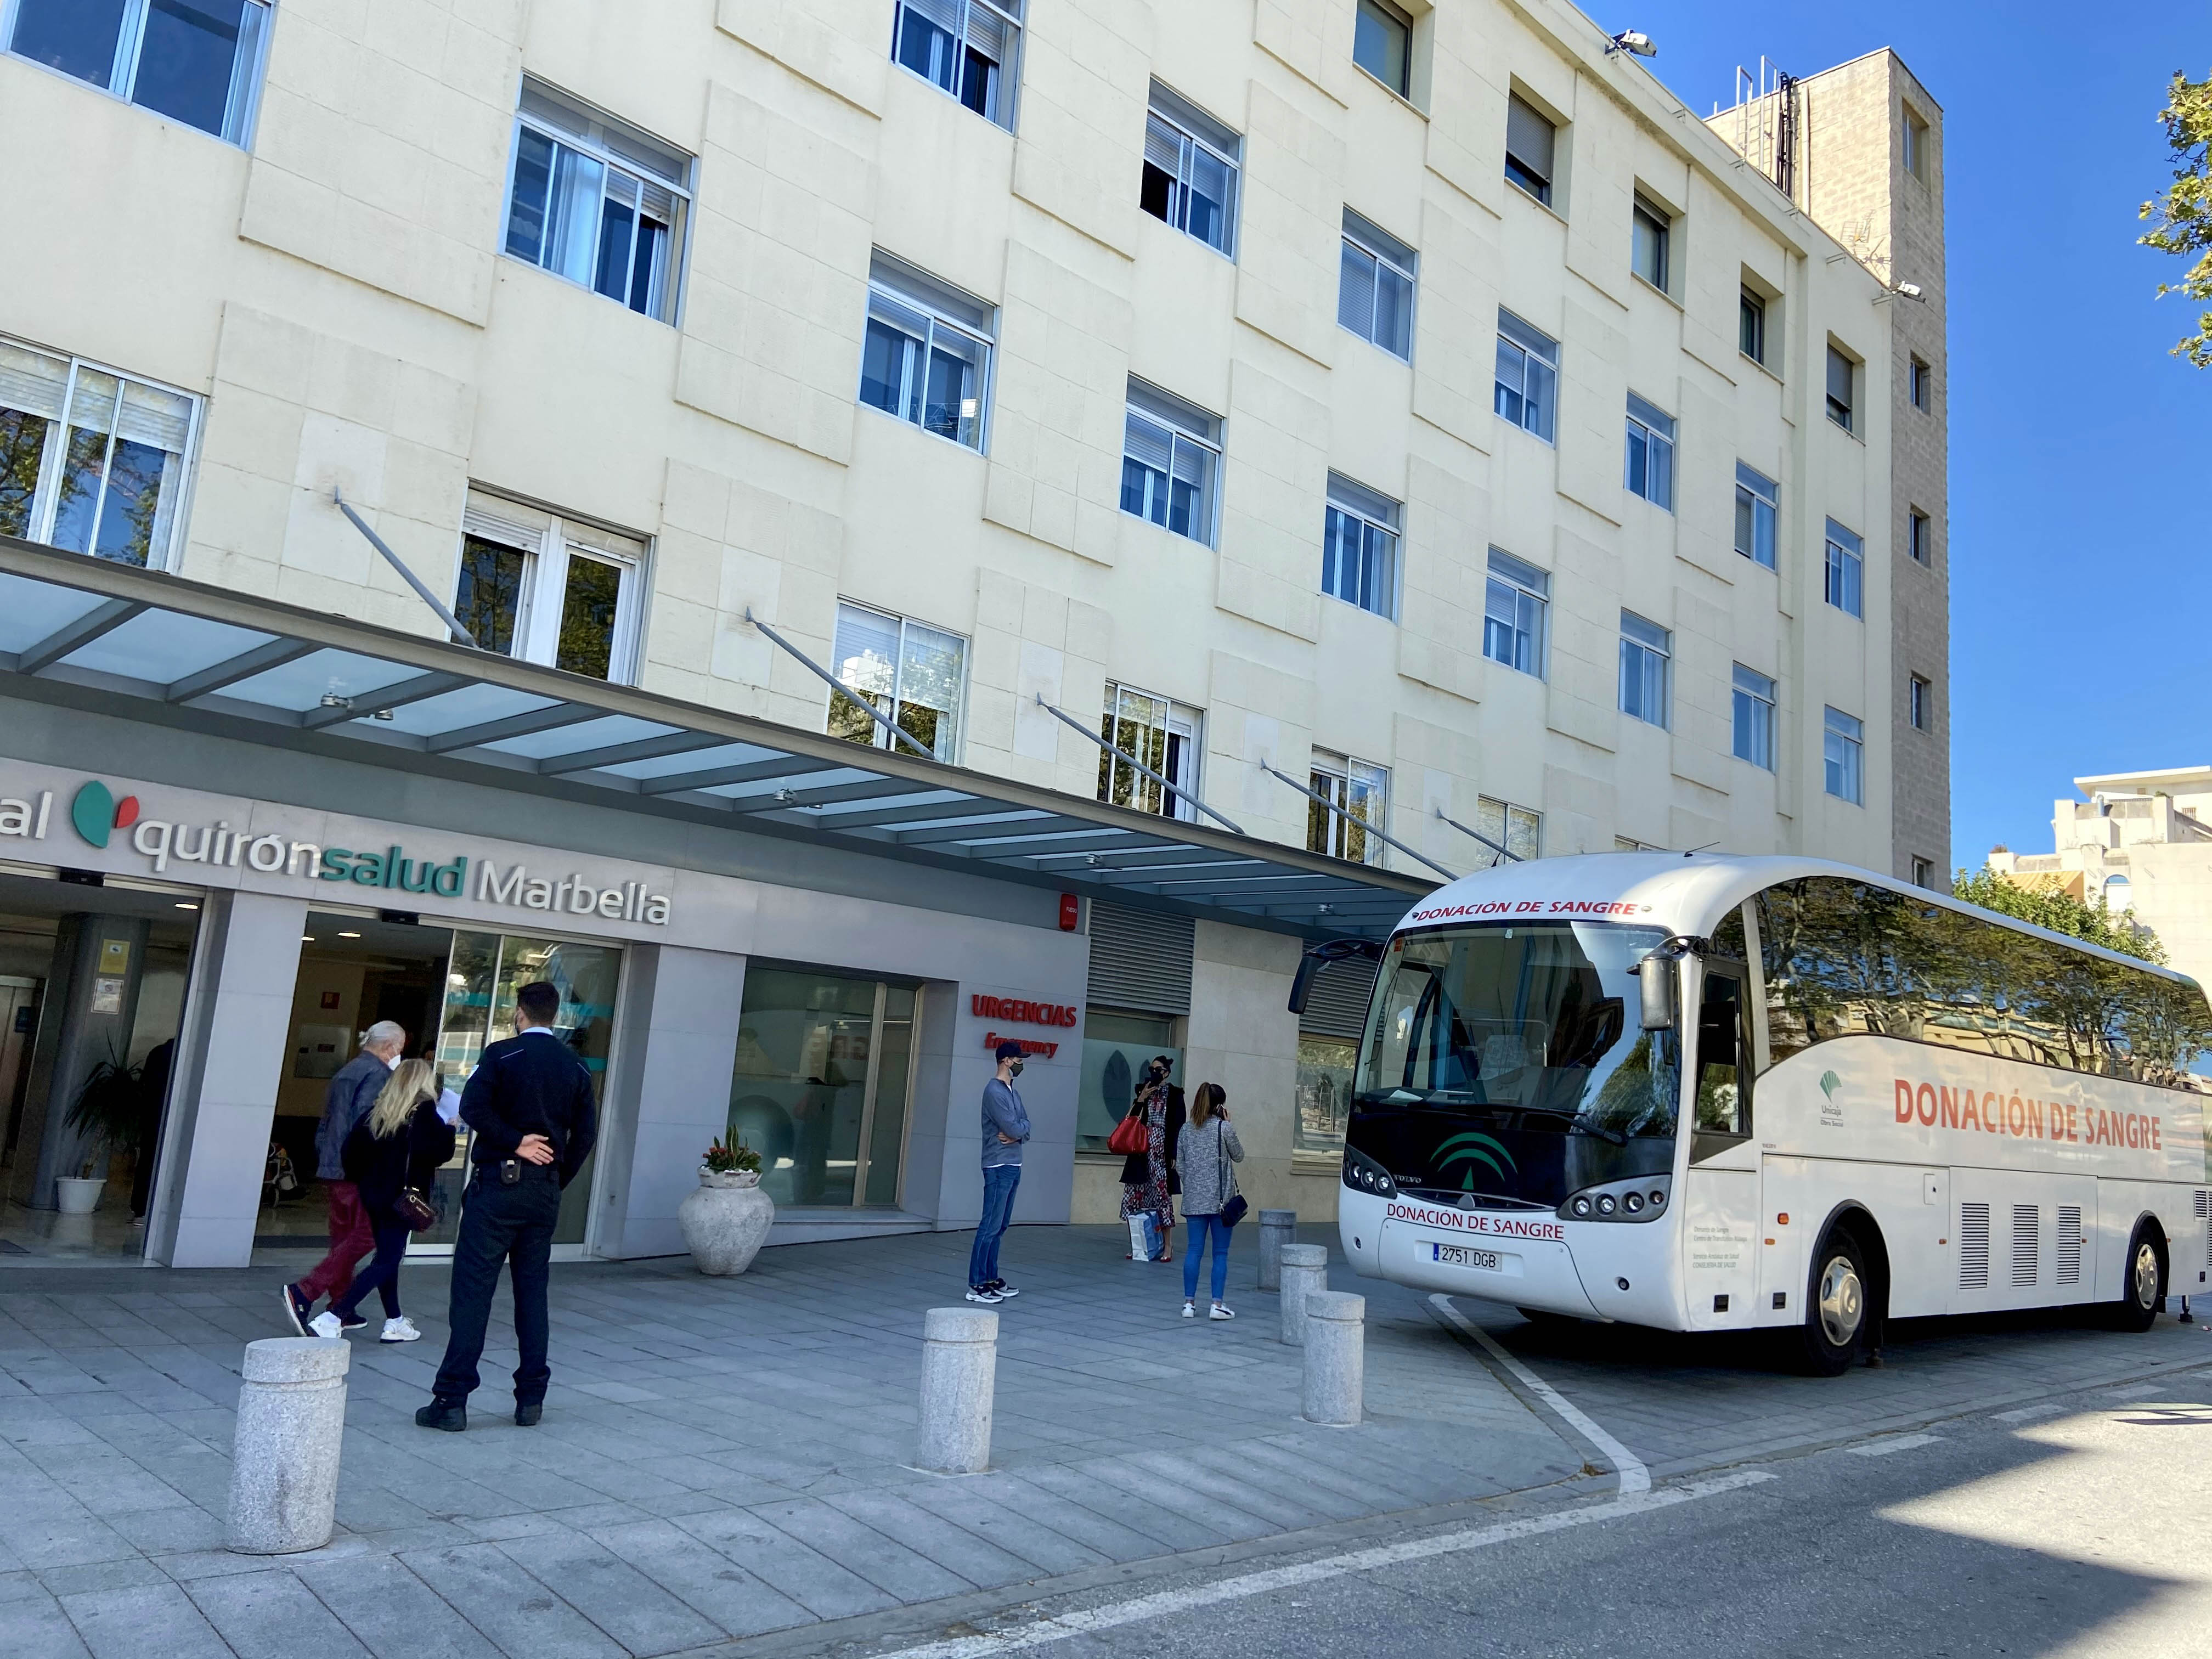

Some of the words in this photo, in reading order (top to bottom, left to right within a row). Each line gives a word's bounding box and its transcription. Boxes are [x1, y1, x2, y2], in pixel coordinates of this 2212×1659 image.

[477, 860, 672, 926] Marbella
[1417, 900, 1512, 921] DONACIÓN
[1515, 901, 1544, 912] DE
[1548, 901, 1638, 915] SANGRE
[972, 994, 1077, 1027] URGENCIAS
[1821, 1104, 1842, 1117] Unicaja
[1894, 1079, 2043, 1139] DONACIÓN
[2050, 1102, 2078, 1142] DE
[2085, 1107, 2162, 1150] SANGRE
[1393, 1174, 1421, 1183] VOLVO
[1387, 1203, 1463, 1227] DONACIÓN
[1468, 1216, 1488, 1231] DE
[1493, 1219, 1564, 1239] SANGRE
[1442, 1247, 1467, 1263] 2751
[1474, 1251, 1496, 1267] DGB
